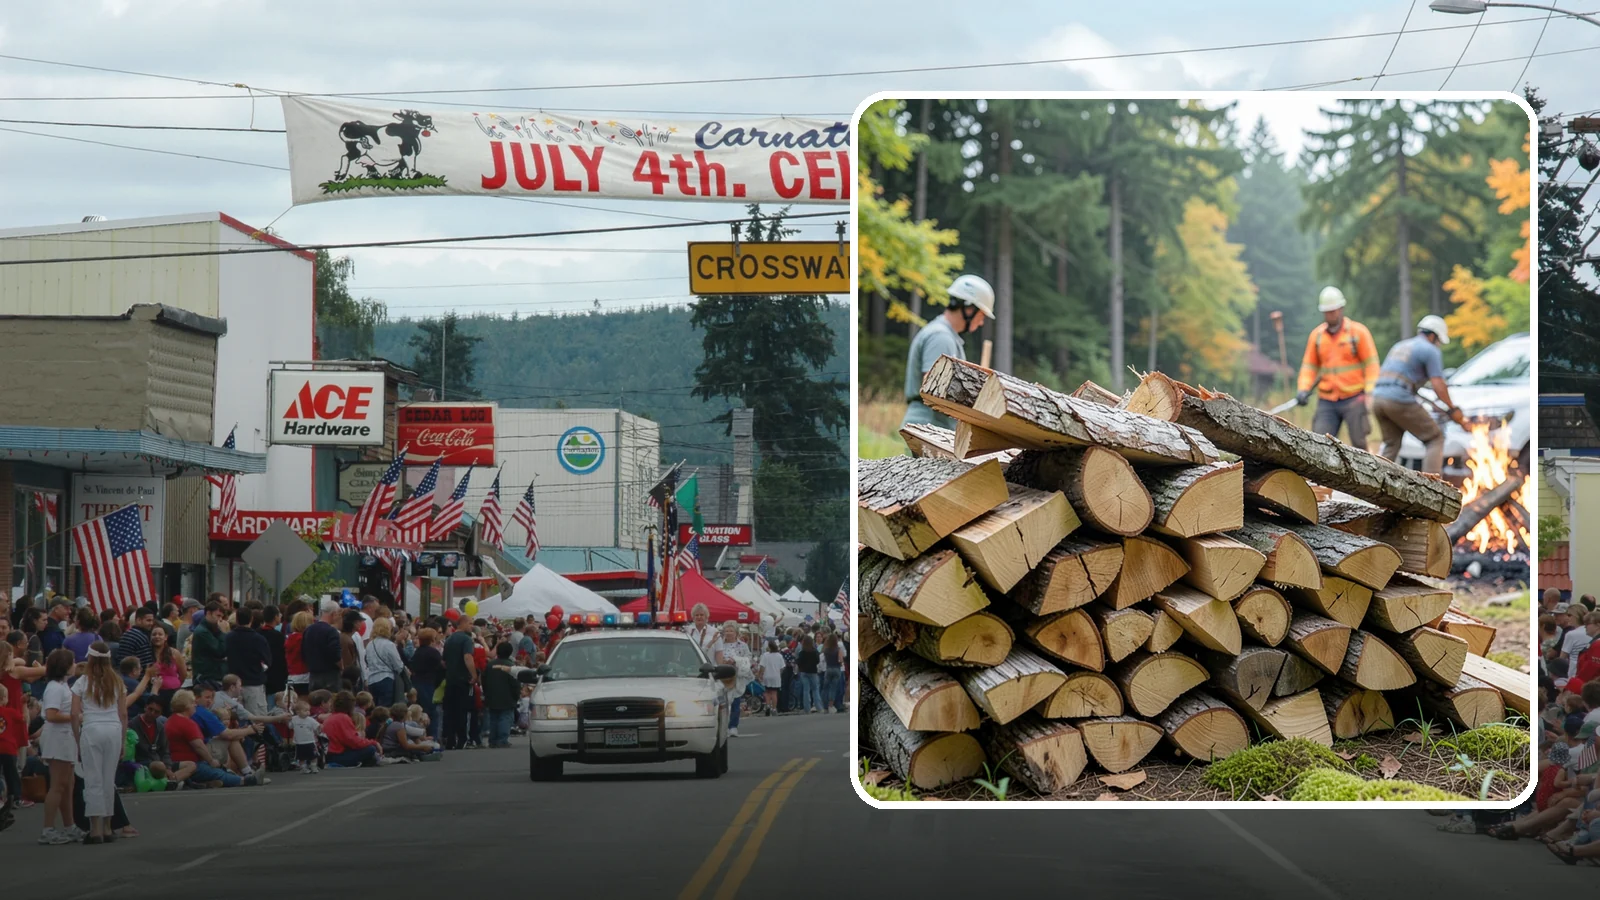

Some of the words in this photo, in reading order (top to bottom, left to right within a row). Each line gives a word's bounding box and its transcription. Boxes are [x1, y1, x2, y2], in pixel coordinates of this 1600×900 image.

[481, 141, 605, 193] JULY
[633, 149, 746, 197] 4th.
[697, 254, 850, 280] CROSSWA
[283, 380, 373, 420] ACE
[405, 409, 453, 422] CEDAR
[461, 409, 486, 422] LOG
[284, 421, 371, 437] Hardware
[416, 428, 477, 447] Coca-Cola
[353, 466, 384, 480] Simpl
[96, 485, 124, 495] Vincent
[126, 486, 136, 495] de
[137, 485, 155, 496] Paul
[81, 503, 154, 522] THT
[688, 526, 741, 535] CRNATION
[699, 535, 730, 543] GLASS
